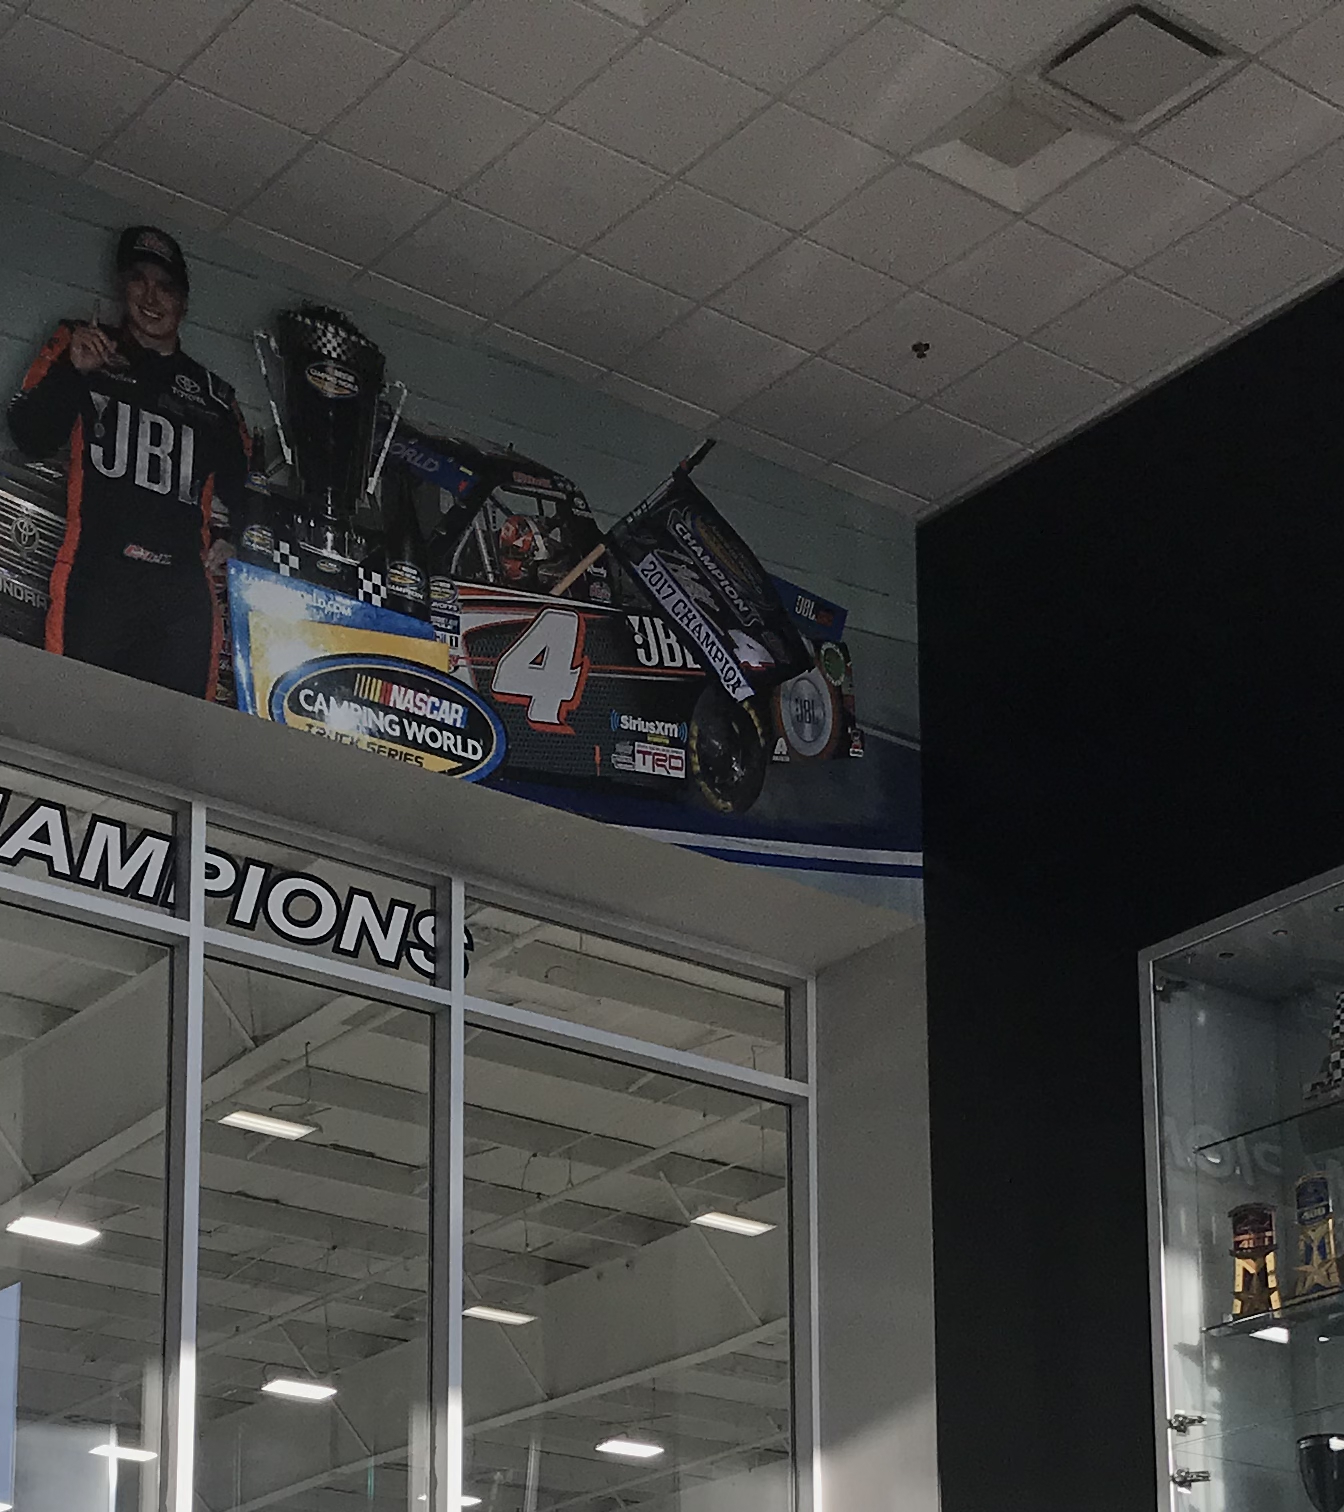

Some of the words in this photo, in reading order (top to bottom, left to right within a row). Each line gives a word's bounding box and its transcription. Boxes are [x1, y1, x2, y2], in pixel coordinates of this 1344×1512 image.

[88, 400, 200, 506] JBL
[640, 560, 677, 602] 2017
[794, 595, 817, 620] JBL
[492, 607, 583, 725] 4
[298, 688, 401, 736] CAMPING
[403, 718, 484, 762] WORLD
[390, 686, 464, 728] NASCAR
[794, 697, 818, 725] JBL
[636, 749, 685, 775] TRD
